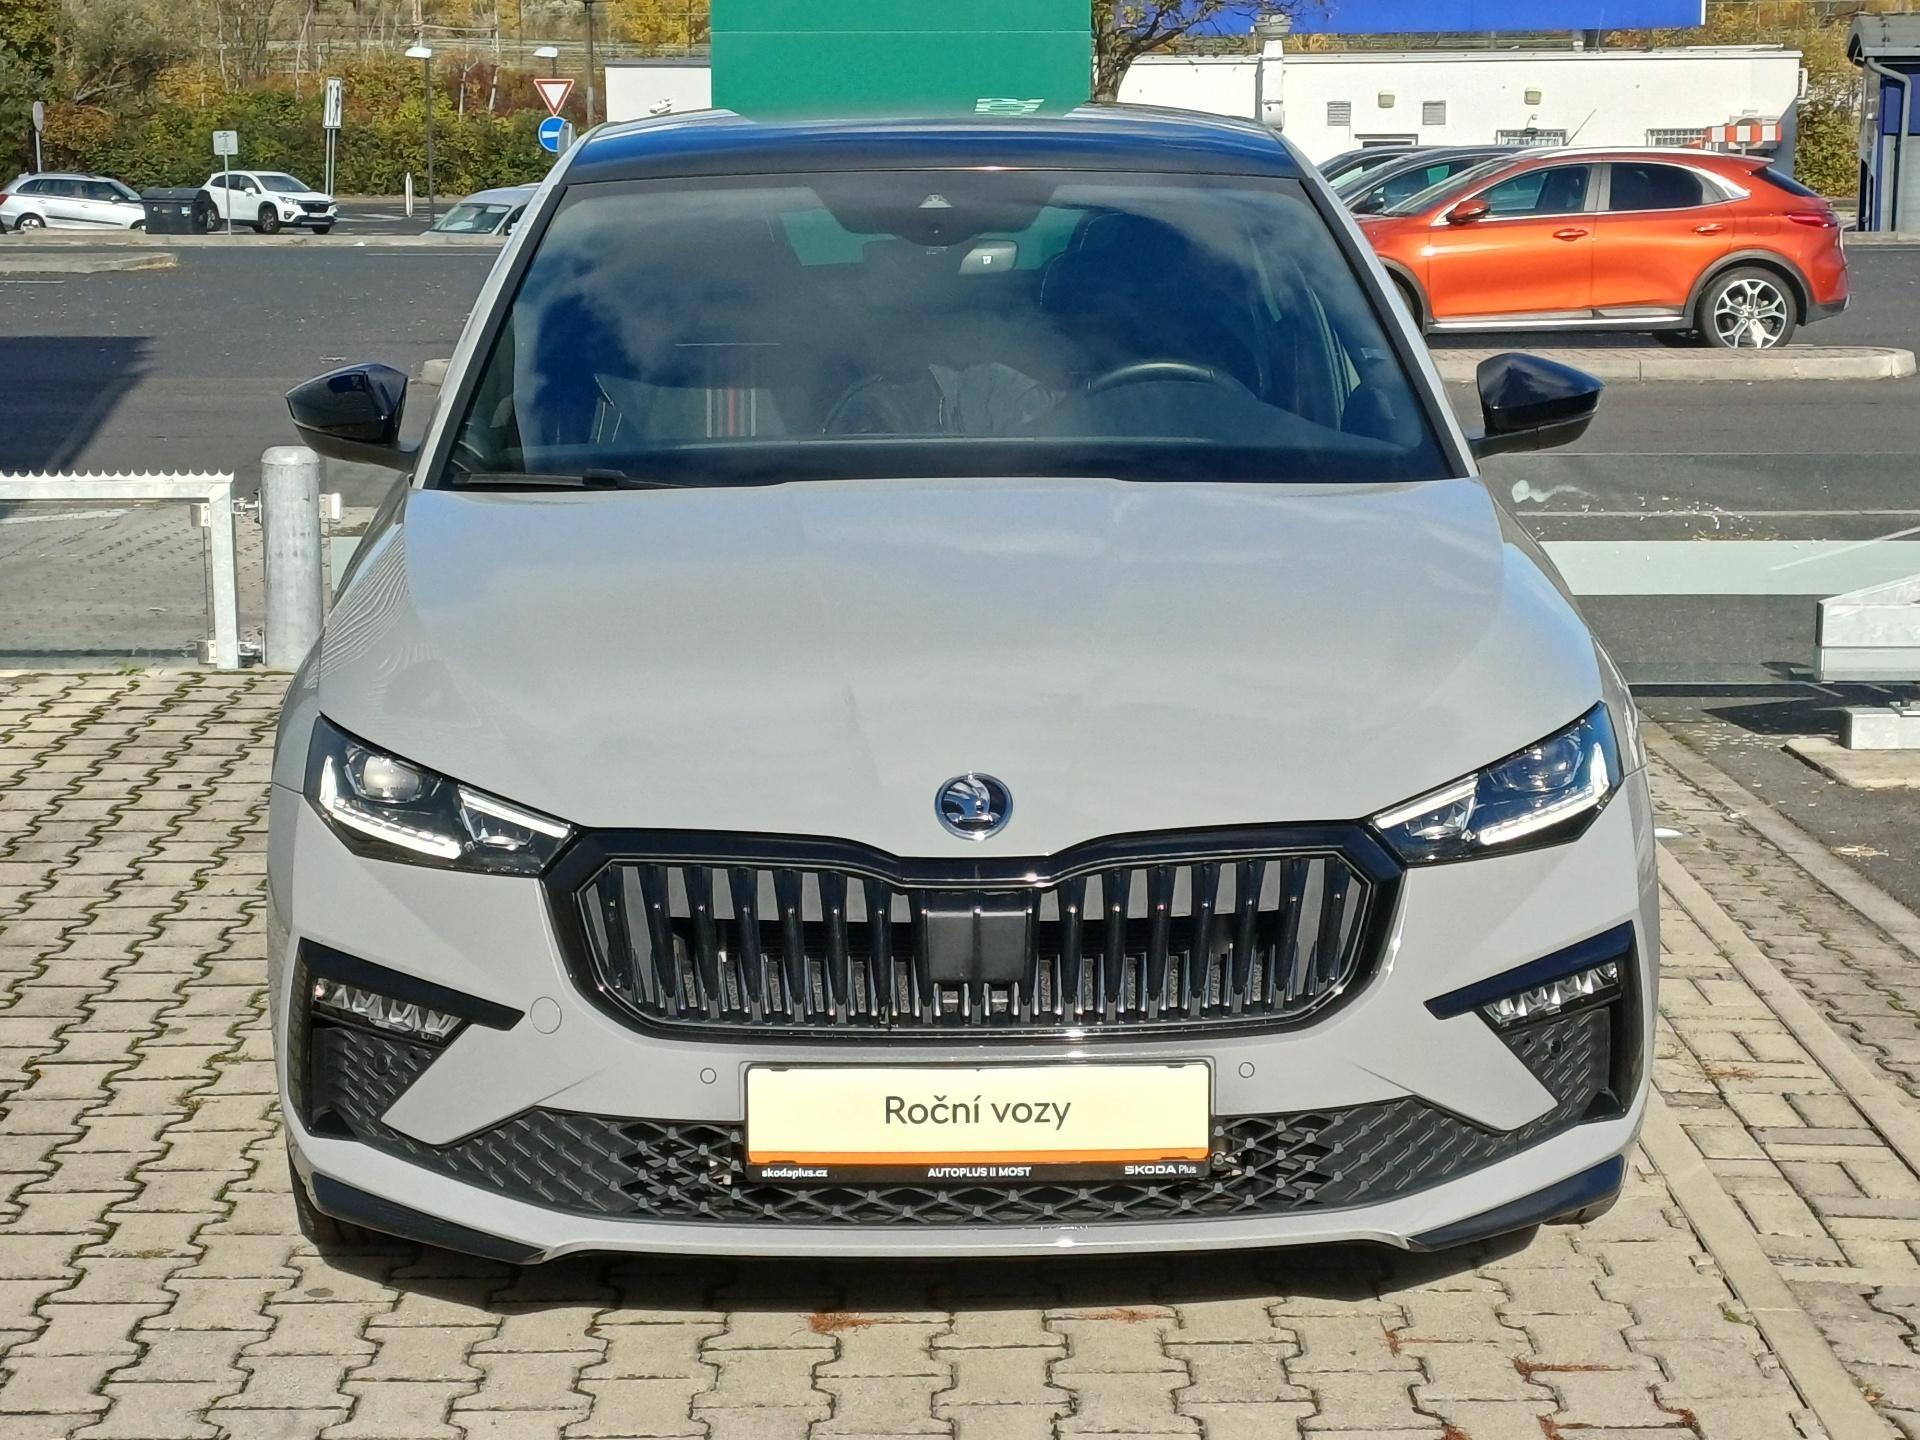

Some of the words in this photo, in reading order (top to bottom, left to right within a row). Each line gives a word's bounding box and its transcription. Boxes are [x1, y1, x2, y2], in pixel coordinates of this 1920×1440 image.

[885, 1094, 982, 1125] Roční
[990, 1102, 1072, 1131] vozy
[761, 1167, 829, 1180] skodaplus.cz
[927, 1167, 988, 1178] AUTOPLUS
[998, 1166, 1032, 1177] MOST
[1178, 1164, 1197, 1174] Plus
